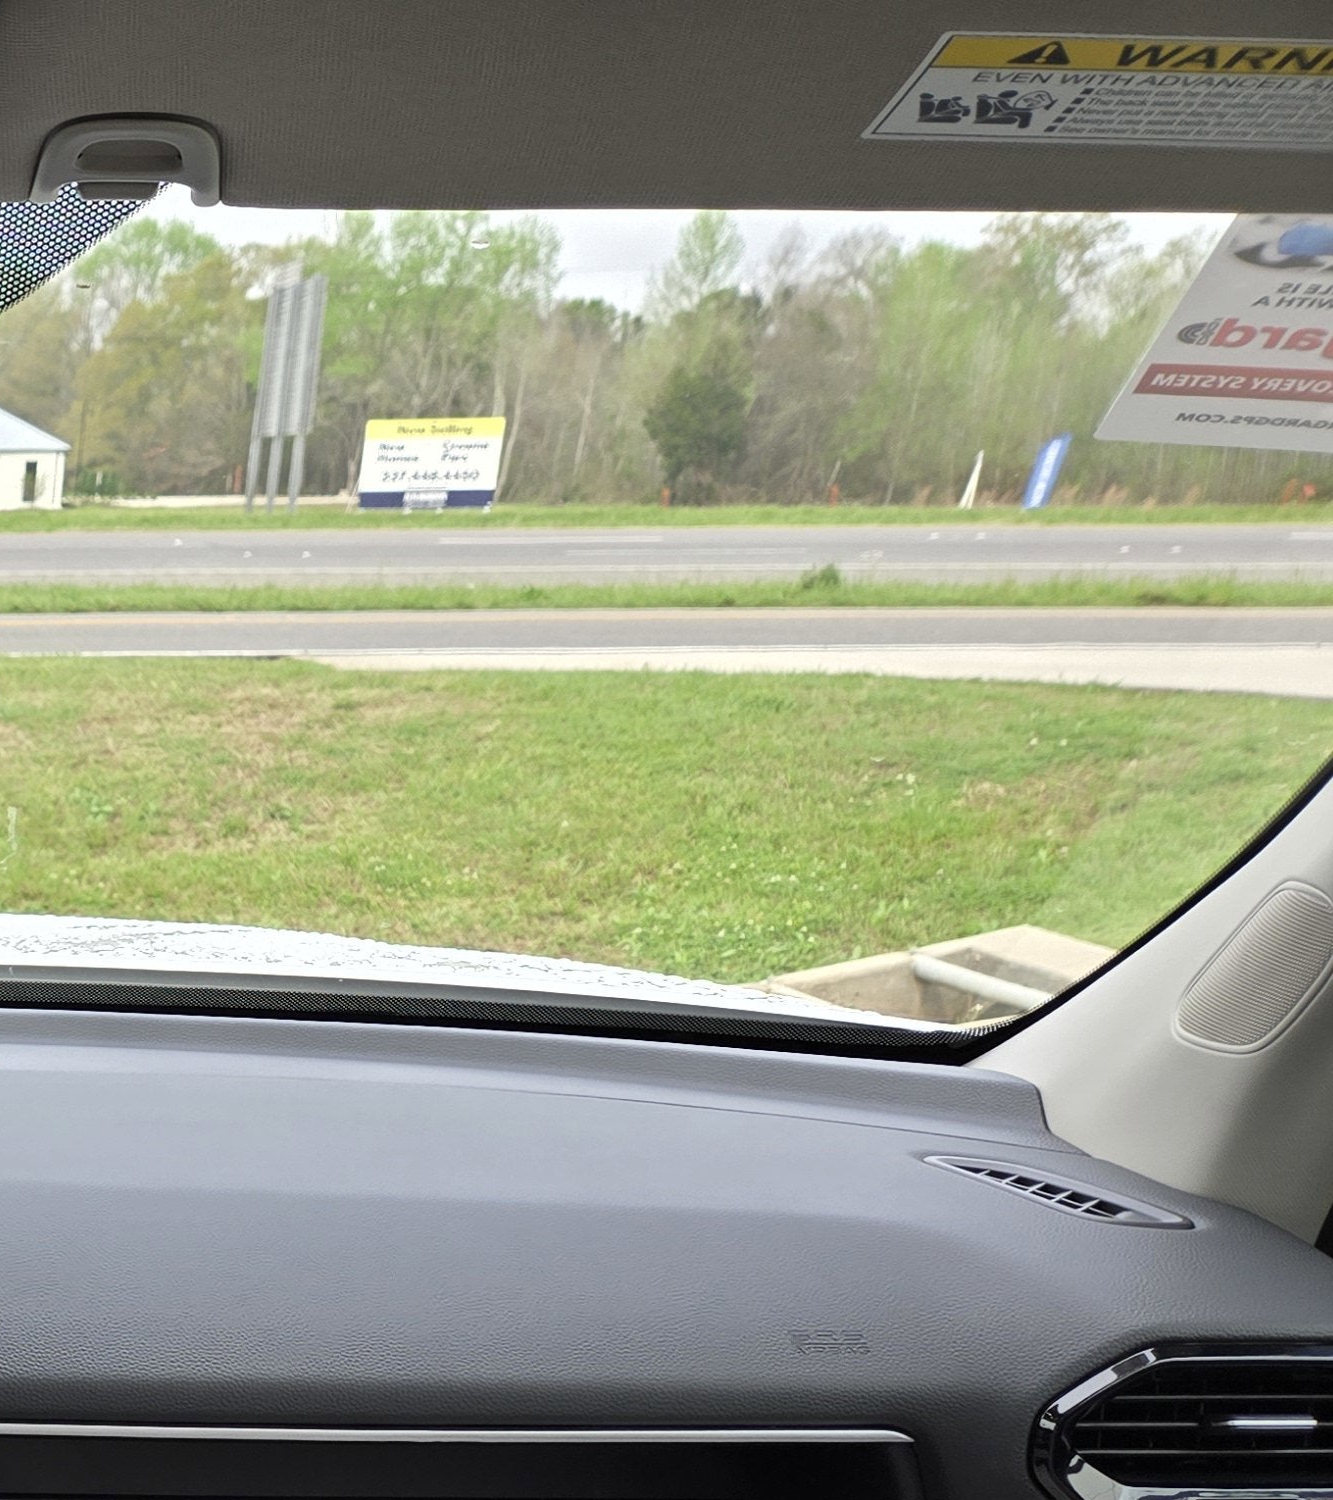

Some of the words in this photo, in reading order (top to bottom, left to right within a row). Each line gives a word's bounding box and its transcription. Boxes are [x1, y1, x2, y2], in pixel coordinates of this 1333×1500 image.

[972, 71, 1049, 83] EVEN
[1060, 73, 1134, 86] WITH
[1136, 76, 1300, 89] ADVANCED
